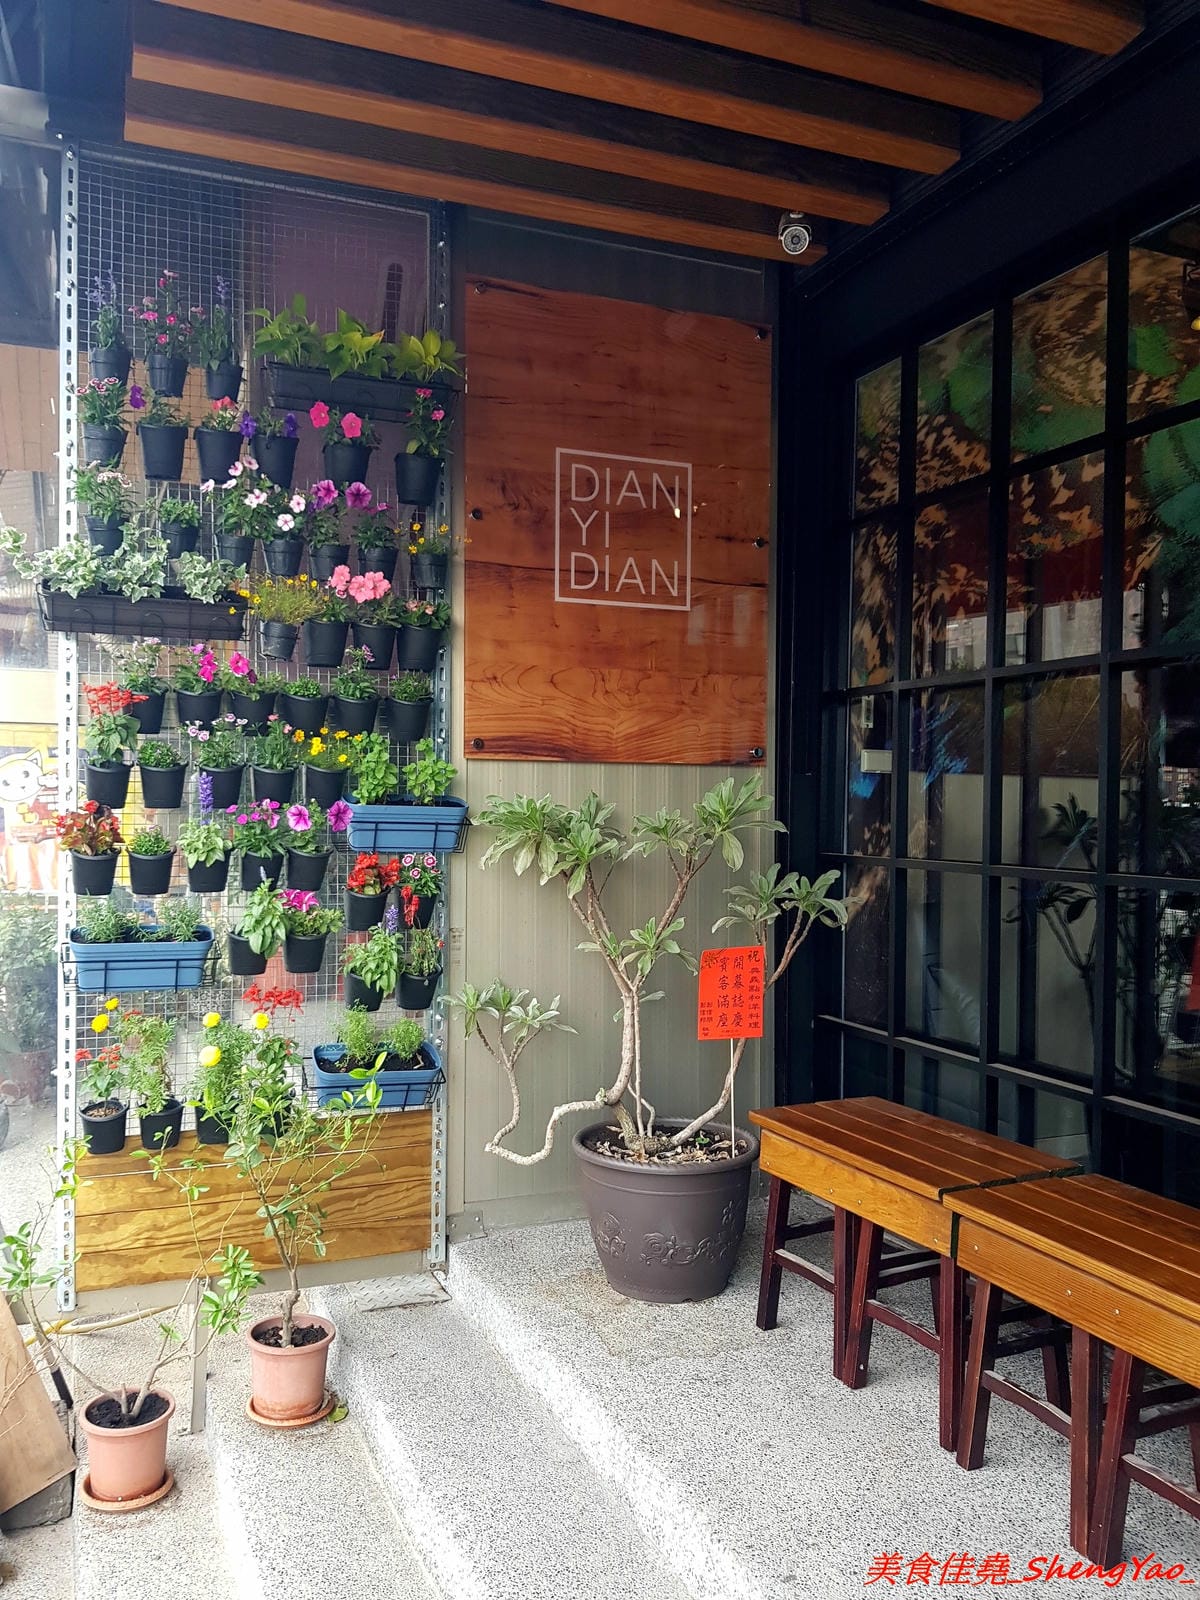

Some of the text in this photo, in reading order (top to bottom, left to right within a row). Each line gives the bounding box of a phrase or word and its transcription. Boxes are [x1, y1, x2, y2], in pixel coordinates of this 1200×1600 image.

[571, 463, 680, 513] DIAN
[570, 507, 610, 548] YI
[570, 552, 679, 597] DIAN
